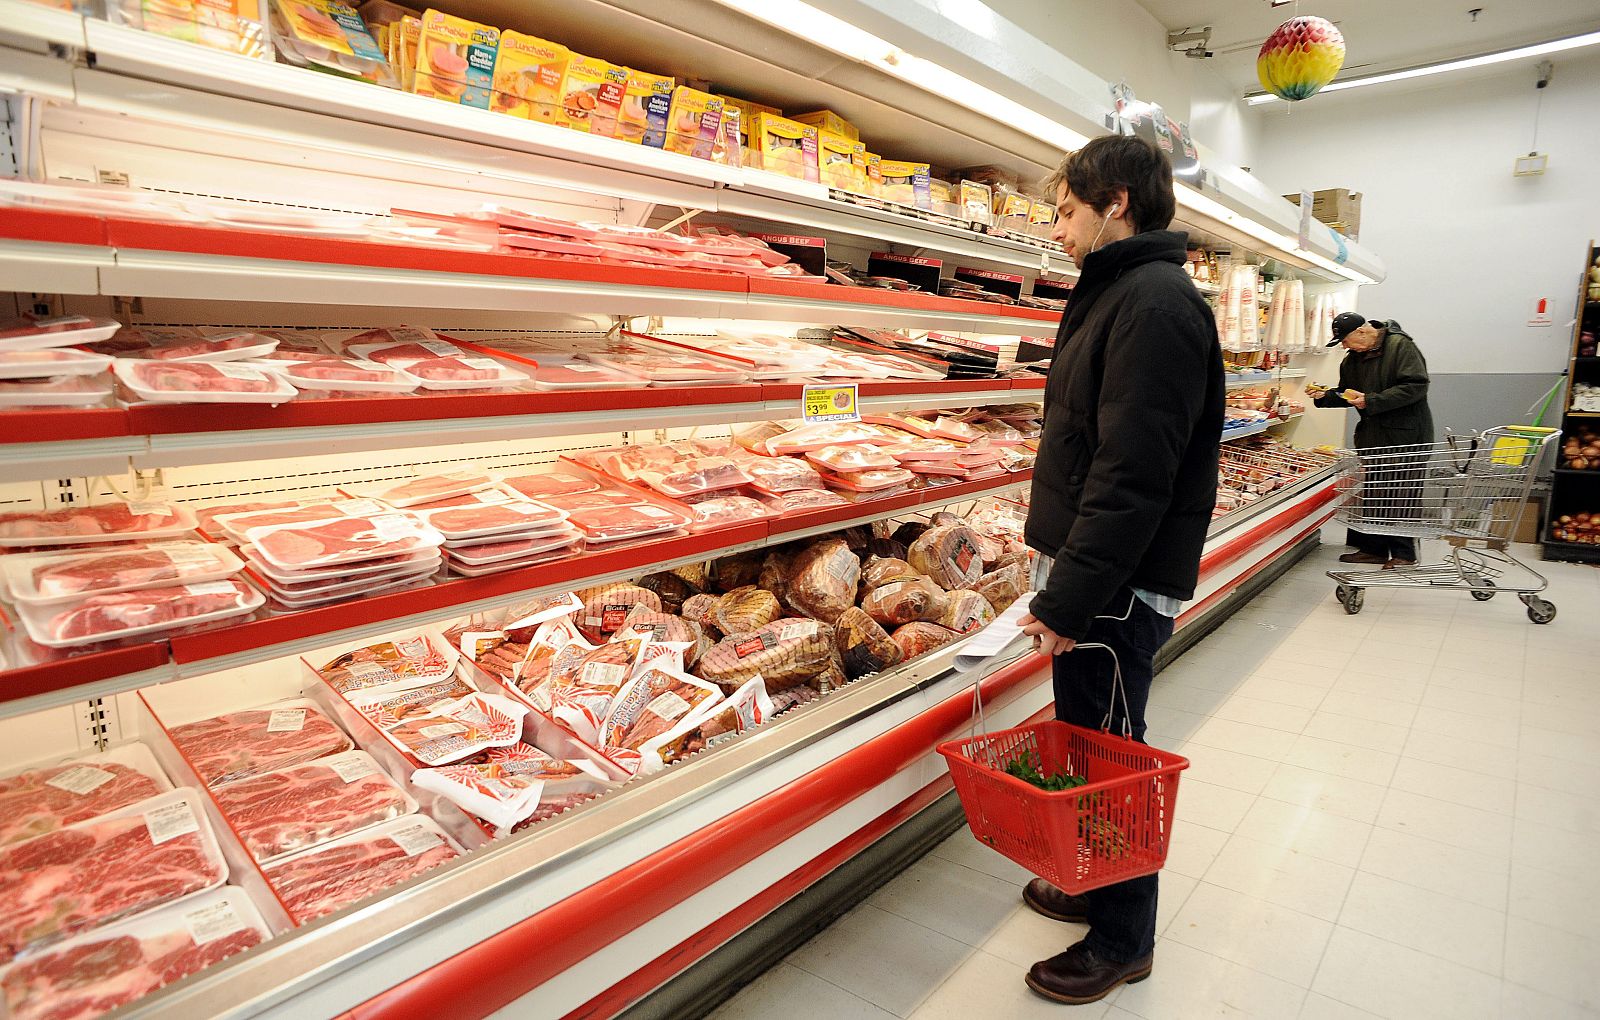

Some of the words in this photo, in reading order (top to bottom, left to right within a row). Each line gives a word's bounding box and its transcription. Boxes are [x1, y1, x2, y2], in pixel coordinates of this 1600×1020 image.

[427, 21, 469, 39] Lunchables
[515, 40, 555, 59] Lunchables
[569, 64, 603, 77] Lunchables
[761, 234, 788, 243] ANGUS
[789, 237, 810, 245] BEEF
[883, 253, 908, 263] ANGUS
[909, 257, 928, 265] BEEF
[968, 270, 992, 278] ANGUS
[940, 335, 965, 345] ANGUS
[966, 339, 986, 350] BEEF
[816, 414, 857, 422] SPECIAL
[387, 689, 432, 709] CORNED
